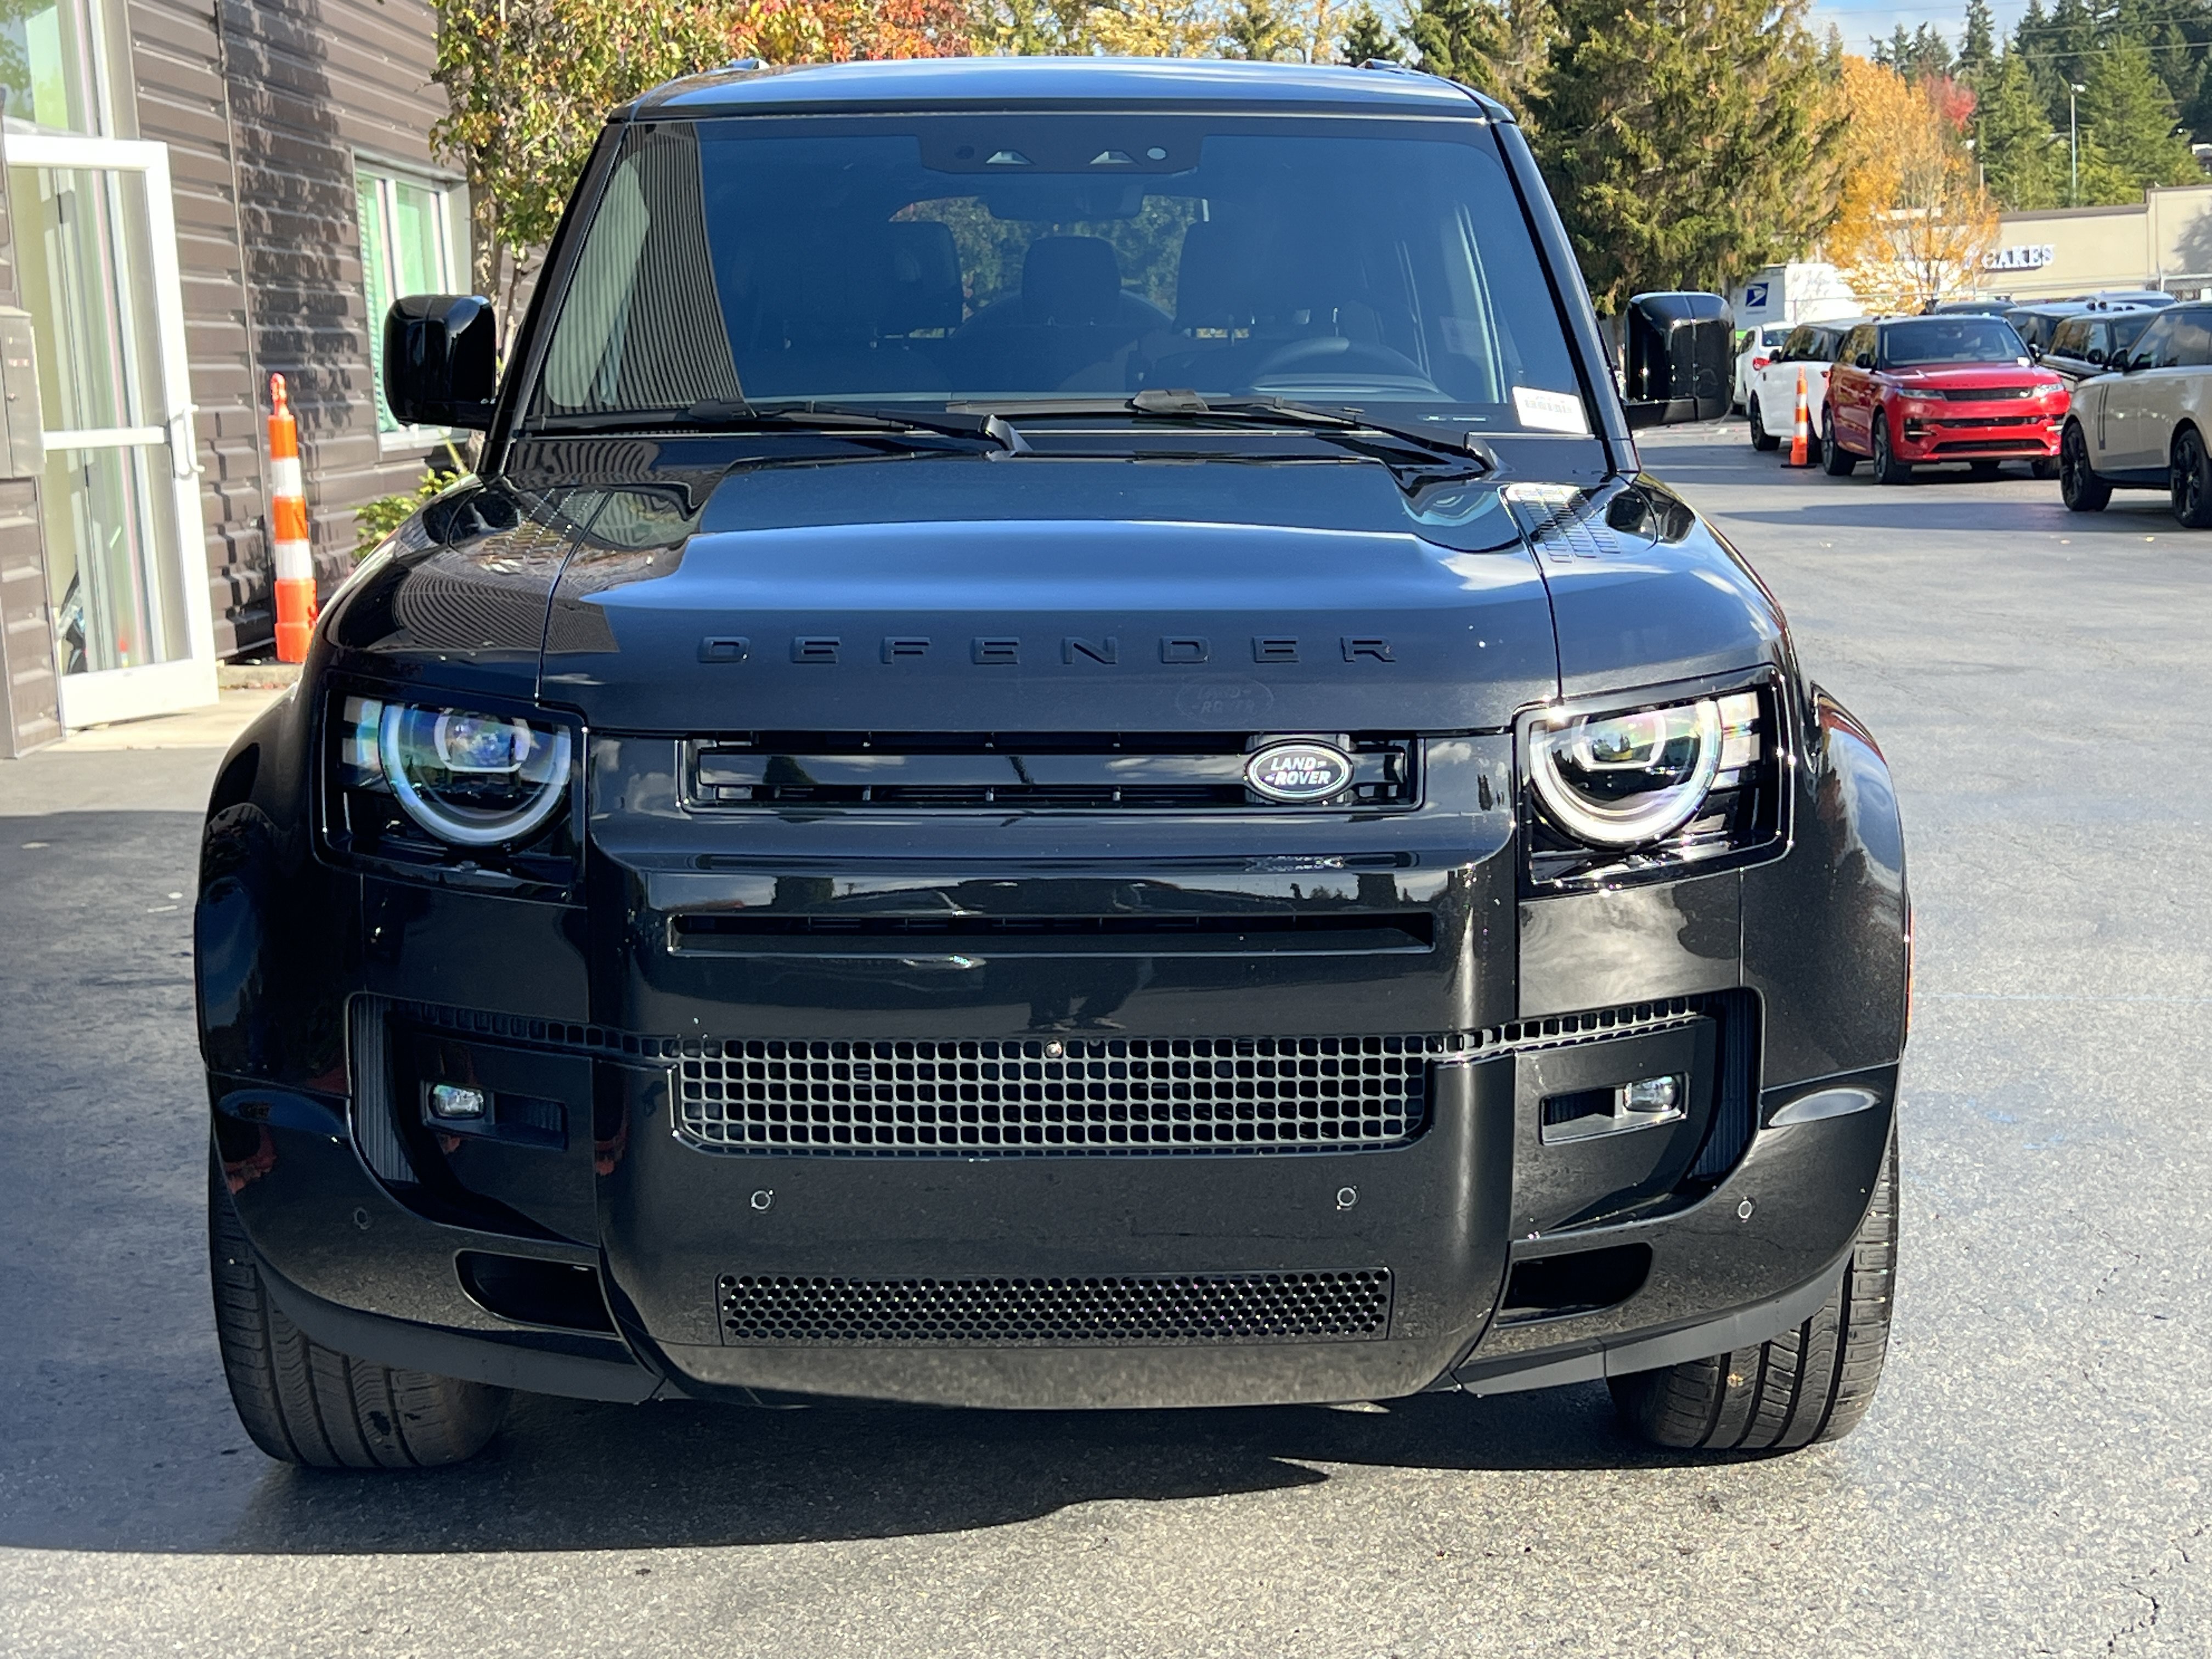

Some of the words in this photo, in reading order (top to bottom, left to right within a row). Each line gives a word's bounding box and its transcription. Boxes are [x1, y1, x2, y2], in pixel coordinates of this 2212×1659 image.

[1980, 244, 2055, 269] CAKES
[697, 636, 1397, 664] DEFENDER
[1270, 757, 1317, 771] LAND
[1274, 771, 1331, 786] ROVER
